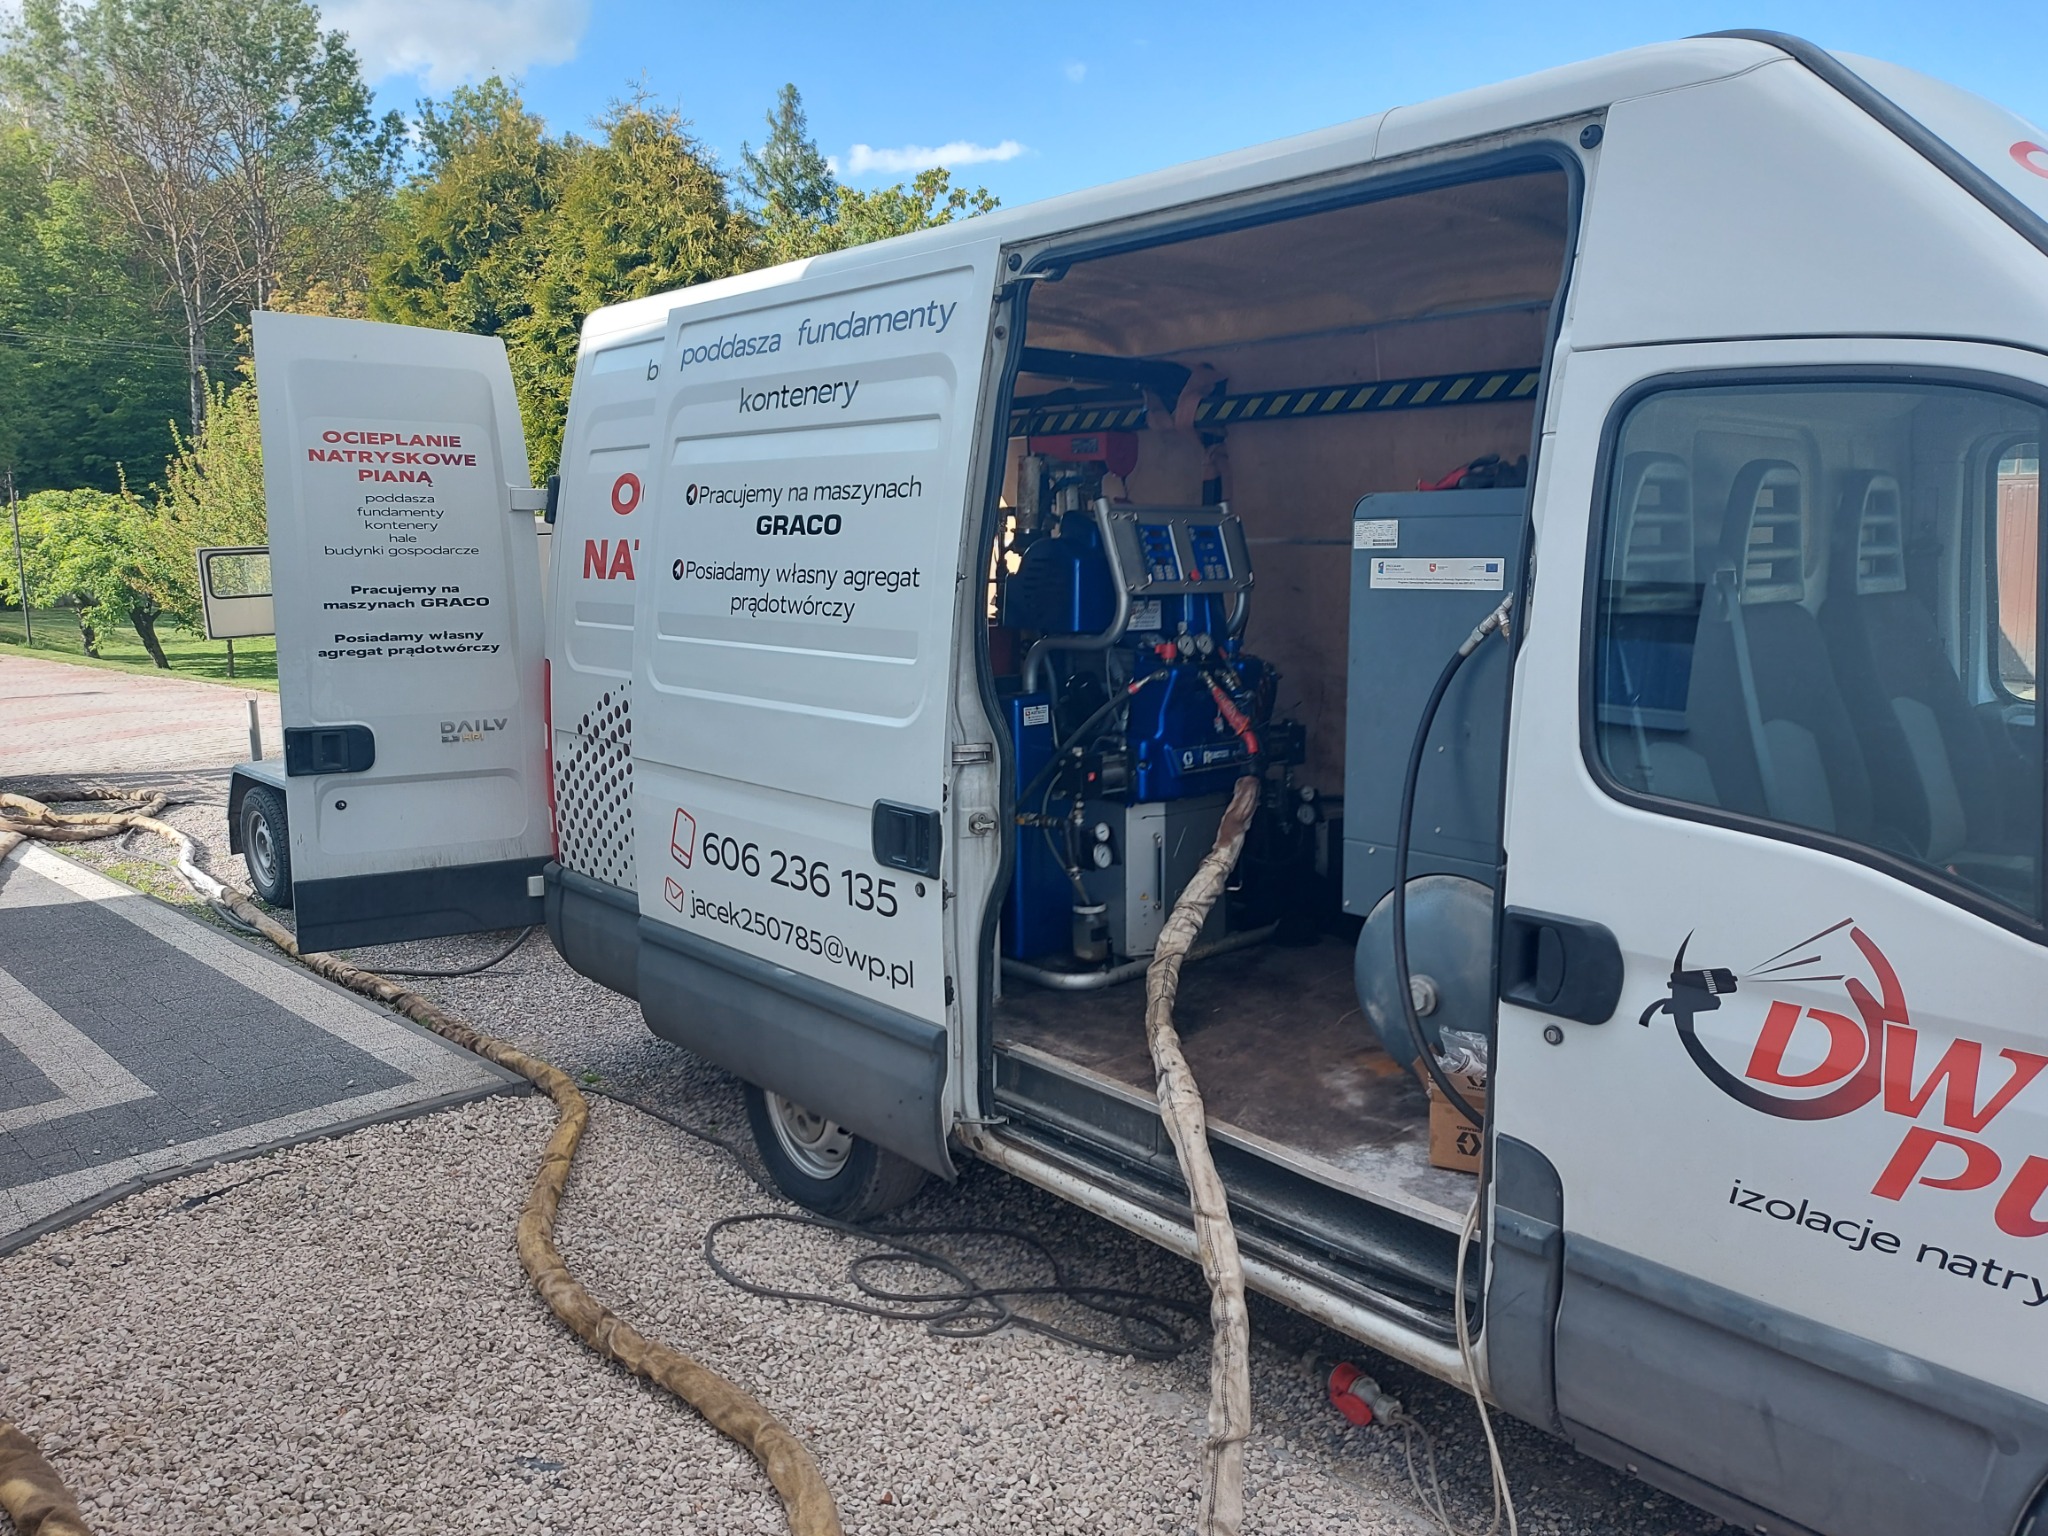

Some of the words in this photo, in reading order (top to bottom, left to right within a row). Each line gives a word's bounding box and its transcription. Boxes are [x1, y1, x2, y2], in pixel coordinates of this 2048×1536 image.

[680, 331, 781, 371] poddasza
[798, 300, 957, 346] fundamenty
[647, 359, 661, 381] b
[739, 379, 859, 413] kontenery
[321, 430, 462, 448] OCIEPLANIE
[308, 448, 477, 467] NATRYSKOWE
[358, 469, 434, 487] PIANĄ
[365, 493, 435, 505] poddasza
[611, 472, 646, 515] O
[699, 485, 782, 508] Pracujemy
[788, 486, 808, 501] na
[813, 475, 922, 503] maszynach
[357, 506, 444, 520] fundamenty
[364, 519, 438, 532] kontenery
[756, 514, 842, 536] GRACO
[389, 533, 417, 544] hale
[324, 545, 384, 557] budynki
[388, 545, 480, 558] gospodarcze
[583, 539, 640, 580] NA
[686, 561, 771, 585] Posiadamy
[776, 564, 837, 590] własny
[843, 566, 920, 592] agregat
[350, 584, 437, 597] Pracujemy
[441, 584, 460, 594] na
[323, 598, 415, 611] maszynach
[420, 596, 490, 608] GRACO
[730, 594, 855, 623] prądotwórczy
[334, 632, 423, 644] Posiadamy
[429, 630, 484, 642] własny
[317, 646, 383, 659] agregat
[388, 642, 500, 657] prądotwórczy
[440, 718, 508, 734] DAILY
[702, 832, 760, 877] 606
[770, 850, 831, 897] 236
[841, 869, 898, 917] 135
[690, 890, 914, 989] jacek250785@wp.pl
[1729, 1179, 1901, 1253] izolacje
[1916, 1243, 2048, 1307] natry
